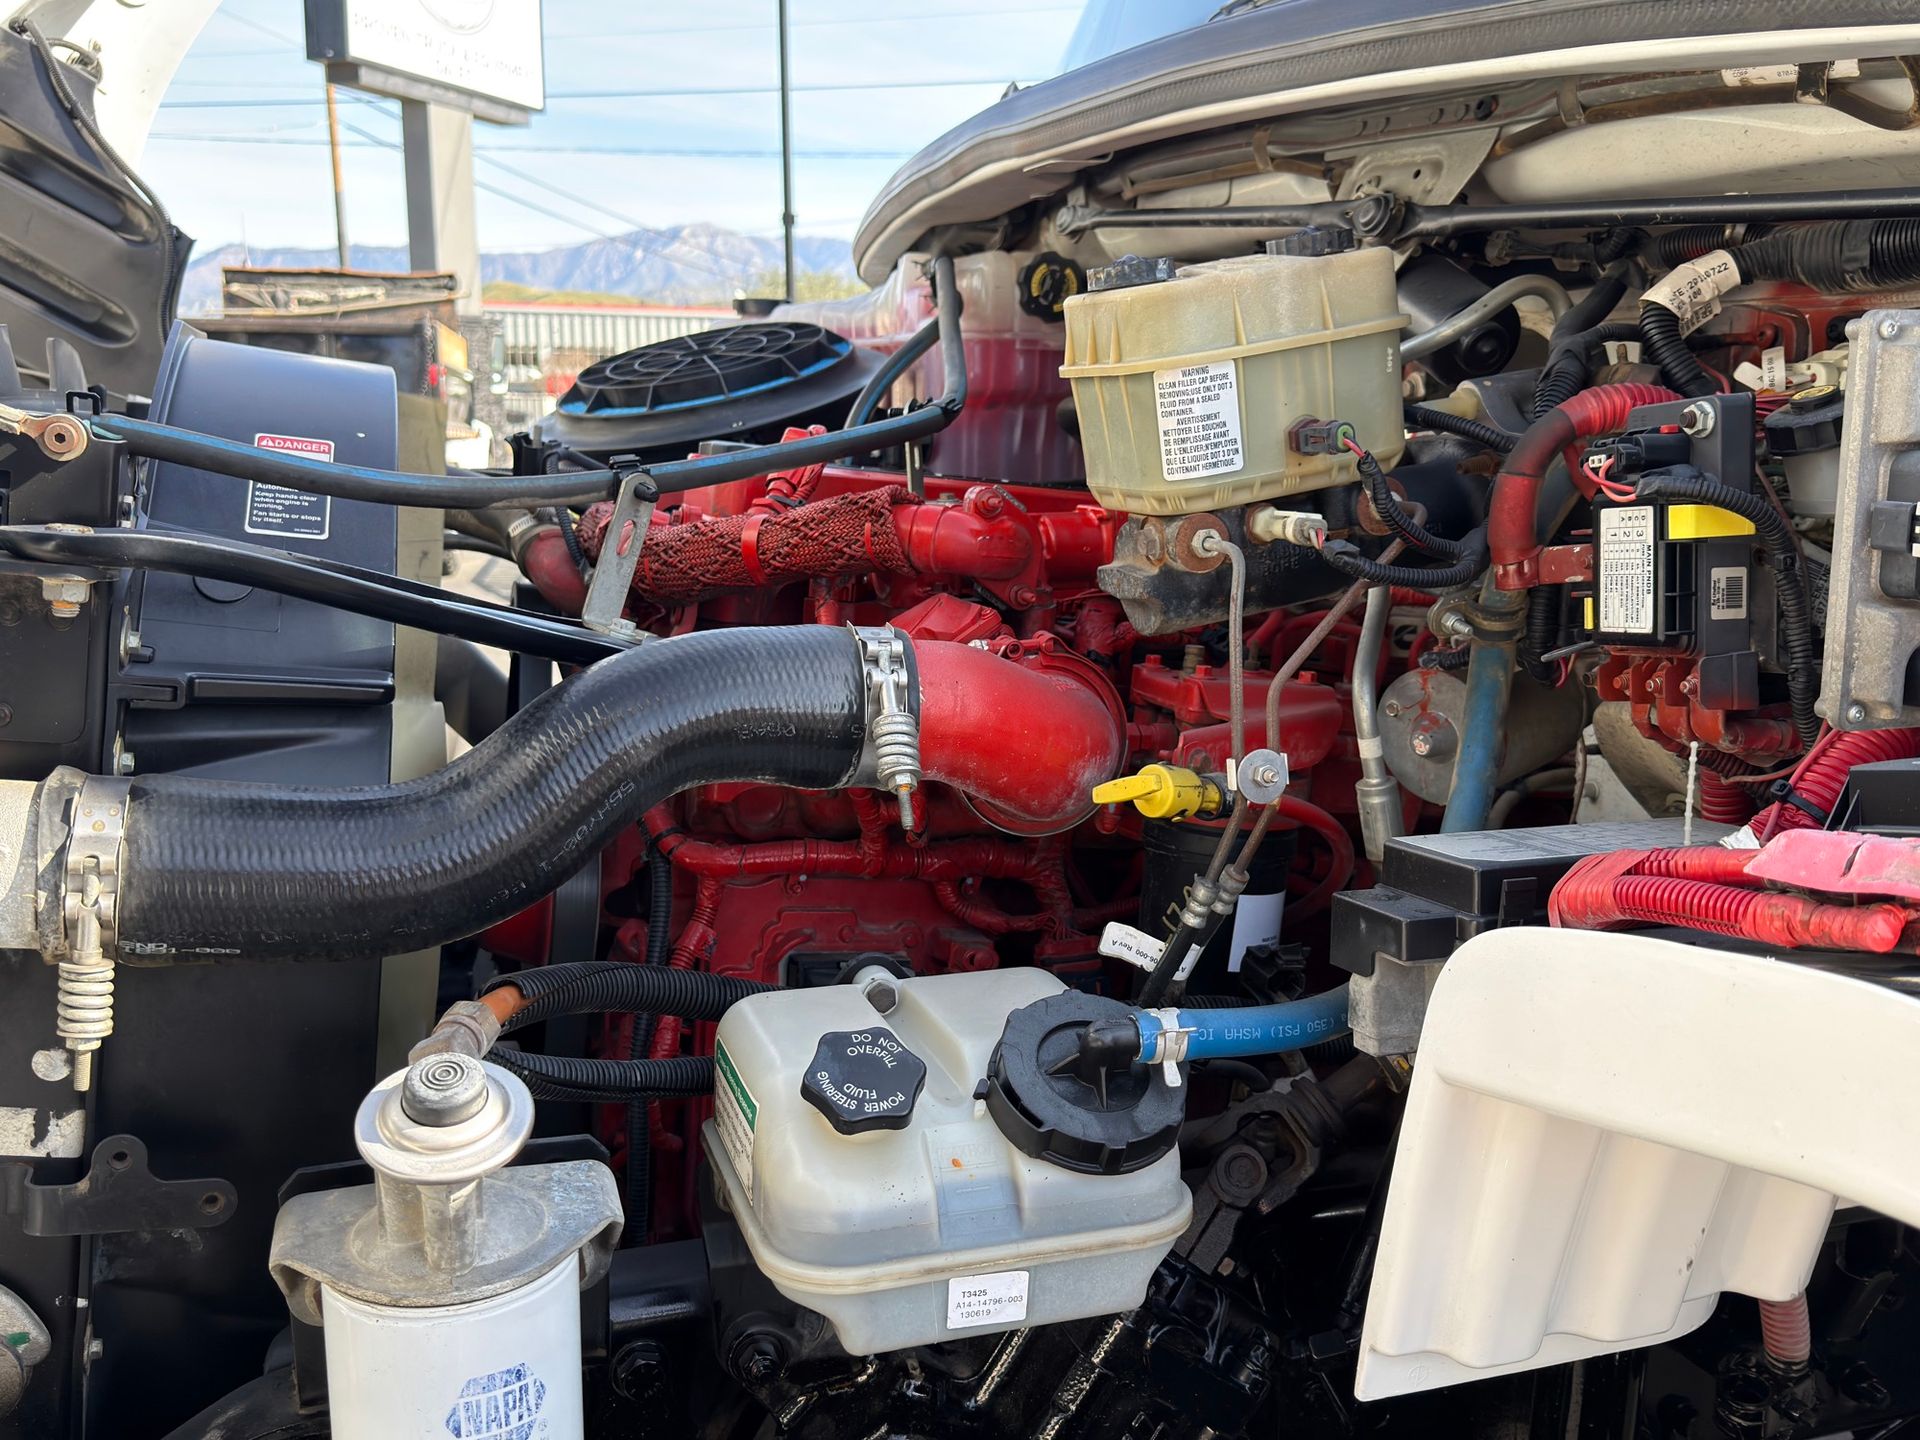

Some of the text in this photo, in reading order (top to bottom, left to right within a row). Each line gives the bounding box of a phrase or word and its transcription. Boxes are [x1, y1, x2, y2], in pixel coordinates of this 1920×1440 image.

[1181, 366, 1210, 378] WARNING
[1158, 372, 1230, 391] CLEAN FILLER CAP BEFORE
[1202, 385, 1216, 394] ONLY
[1218, 382, 1228, 391] DOT
[1160, 393, 1220, 409] FLUID FROM A SEALED
[1160, 408, 1194, 418] CONTAINER.
[1176, 412, 1221, 426] AVERTISSEMENT
[1162, 420, 1227, 438] NETTOYER LE BOUCHON
[1164, 430, 1230, 447] DE REMPLISSAGE AVANT
[275, 440, 329, 453] DANGER
[1164, 448, 1172, 456] DE
[1166, 447, 1240, 466] QUE LE LIQUIDE DOT 3 D'UN
[1166, 464, 1200, 476] CONTENANT
[276, 498, 300, 506] engine
[301, 514, 322, 522] stops
[1623, 530, 1631, 538] 2
[1118, 942, 1133, 952] Rev
[1224, 1029, 1260, 1040] MSHA
[1270, 1024, 1300, 1038] PSI)
[852, 1034, 902, 1054] DO NOT
[847, 1044, 898, 1068] OVERFILL
[818, 1071, 906, 1112] POWER STEERING
[843, 1083, 877, 1099] FLUID
[962, 1289, 988, 1298] T3425
[956, 1295, 1024, 1310] A14-14796-003
[960, 1309, 991, 1318] 130619
[463, 1381, 535, 1438] NAPA
